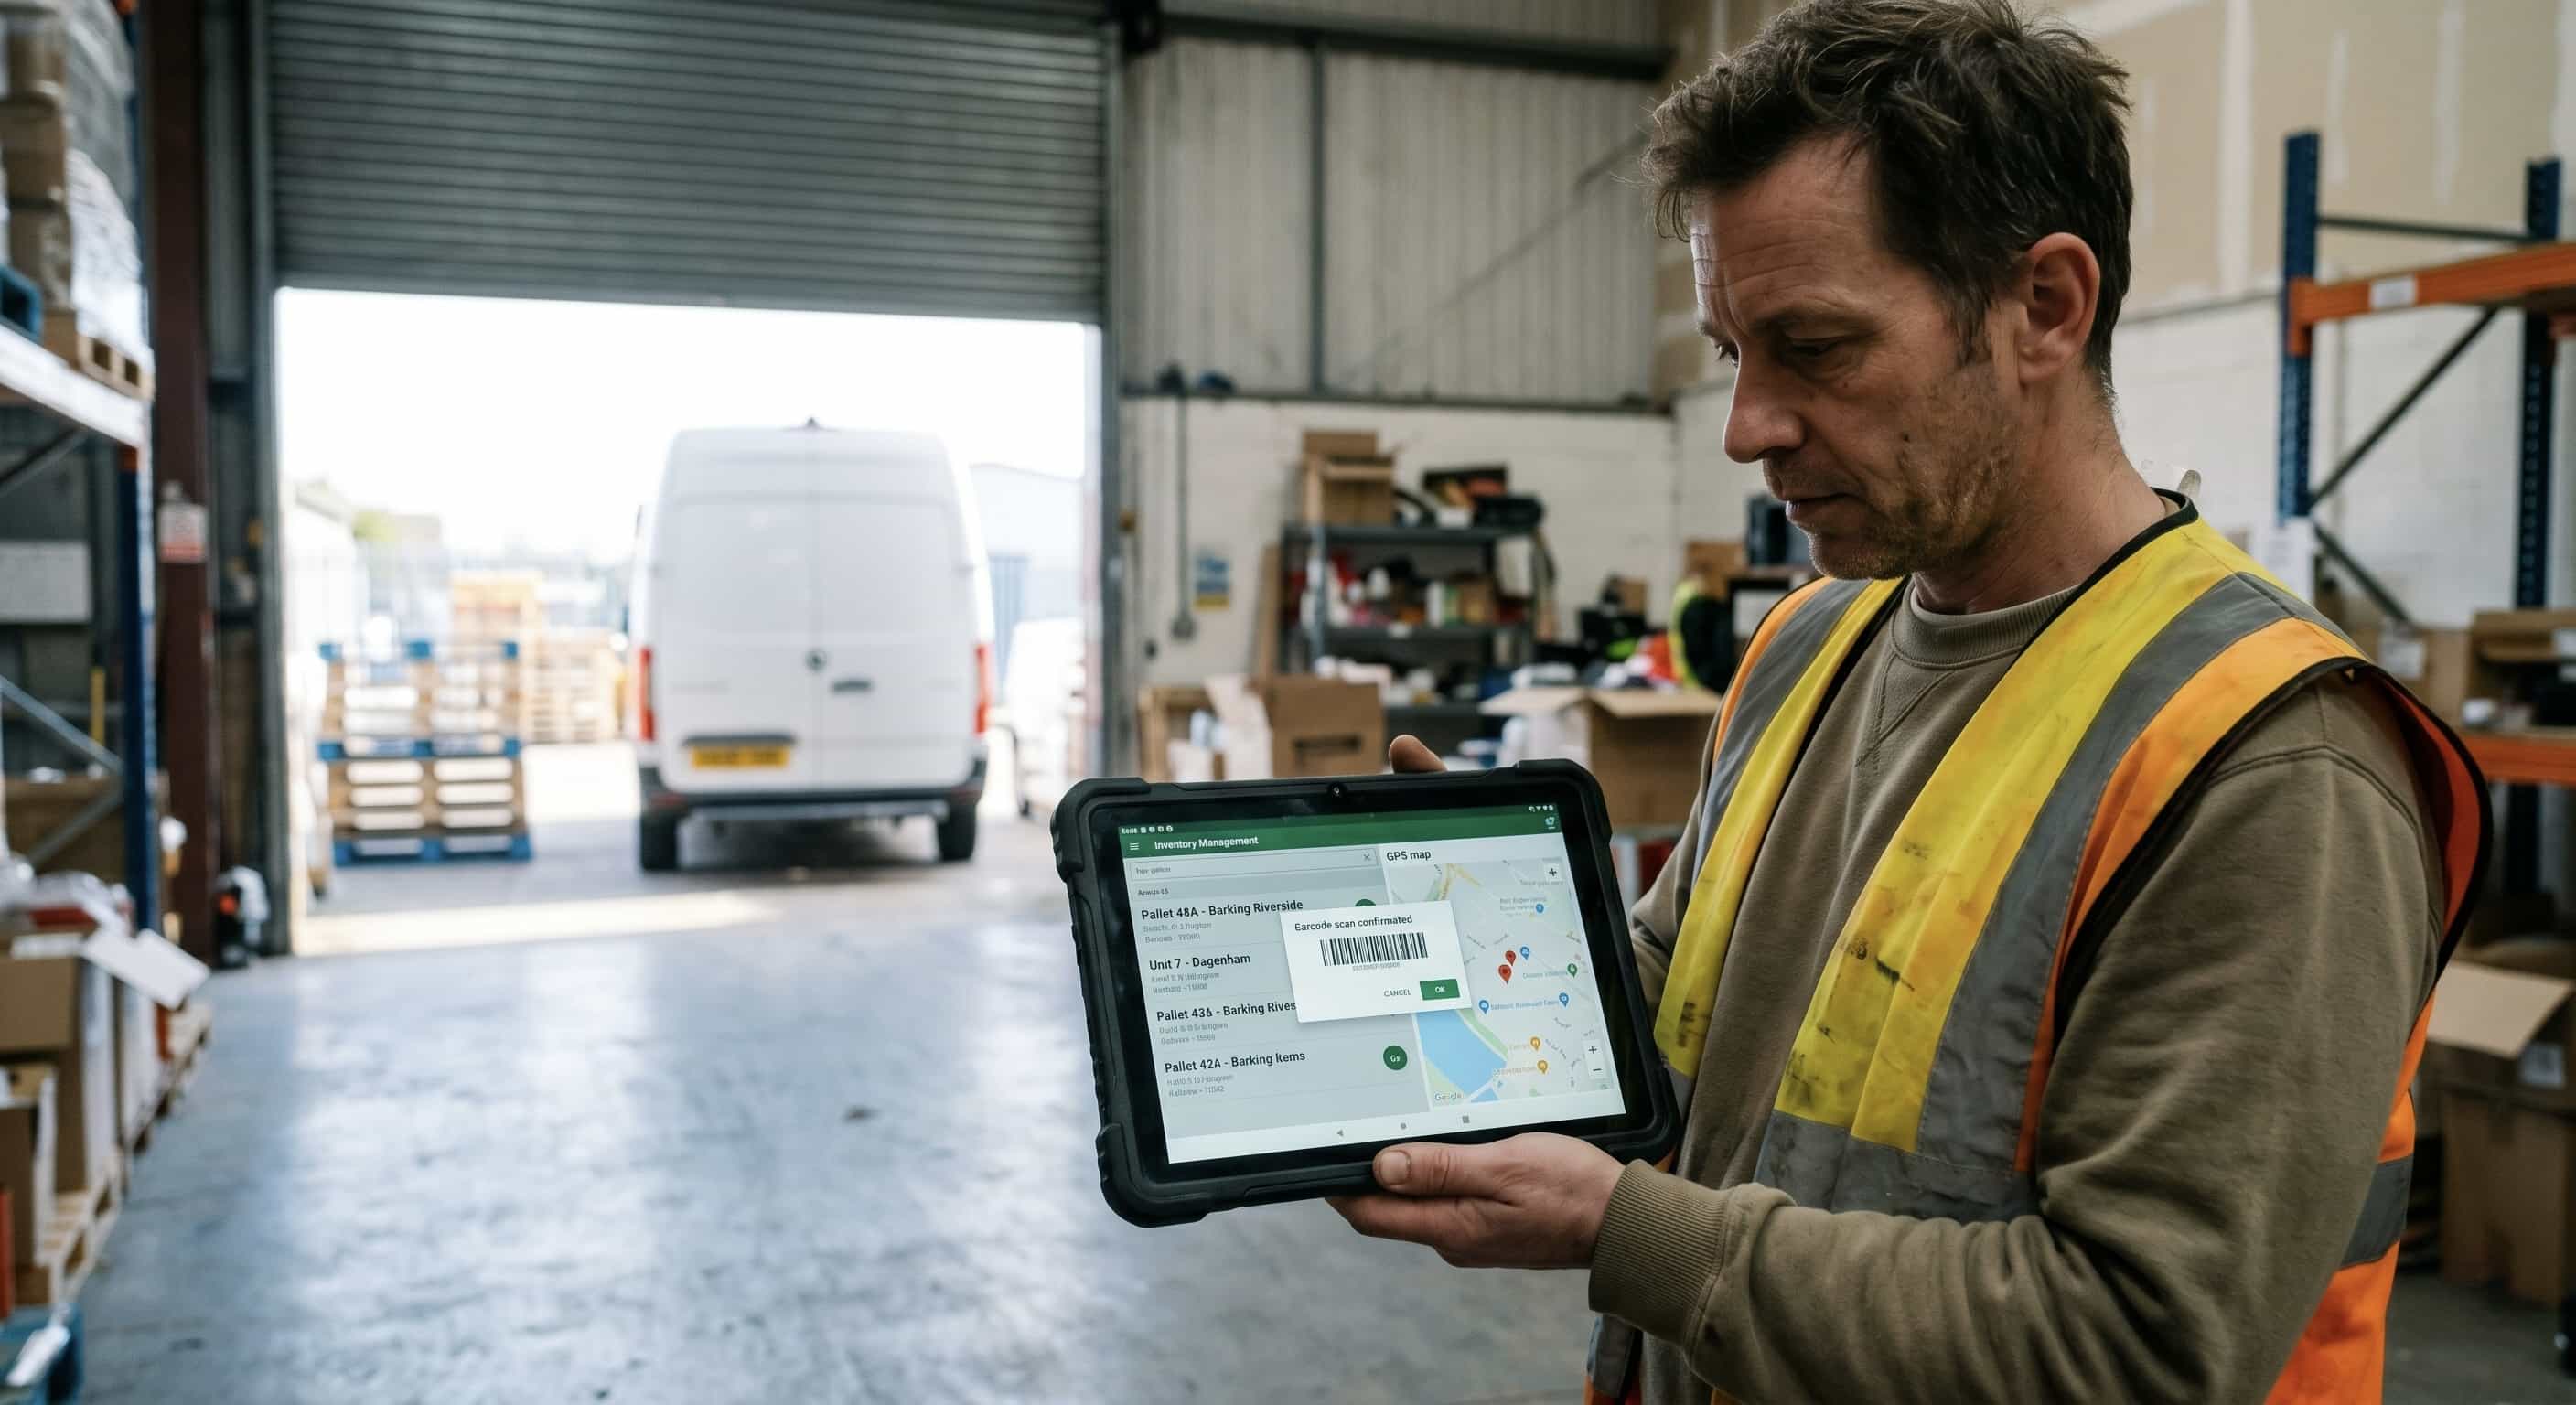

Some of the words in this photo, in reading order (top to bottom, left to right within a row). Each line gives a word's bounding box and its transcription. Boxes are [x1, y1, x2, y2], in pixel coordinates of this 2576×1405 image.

[1154, 839, 1197, 852] Inventory
[1198, 836, 1259, 850] Management
[1387, 851, 1408, 861] GPS
[1411, 851, 1431, 861] map
[1141, 907, 1174, 920] Pallet
[1176, 907, 1198, 918] 48A
[1208, 904, 1250, 916] Barking
[1253, 900, 1304, 913] Riverside
[1335, 919, 1356, 928] scan
[1358, 915, 1412, 928] confirmated
[1149, 959, 1172, 971] Unit
[1175, 958, 1181, 969] 7
[1192, 954, 1251, 969] Dagenham
[1383, 989, 1411, 997] CANCEL
[1434, 985, 1446, 993] OK
[1156, 1010, 1188, 1022] Pallet
[1223, 1003, 1264, 1016] Barking
[1165, 1061, 1197, 1073] Pallet
[1200, 1059, 1221, 1070] 42A
[1231, 1055, 1272, 1067] Barking
